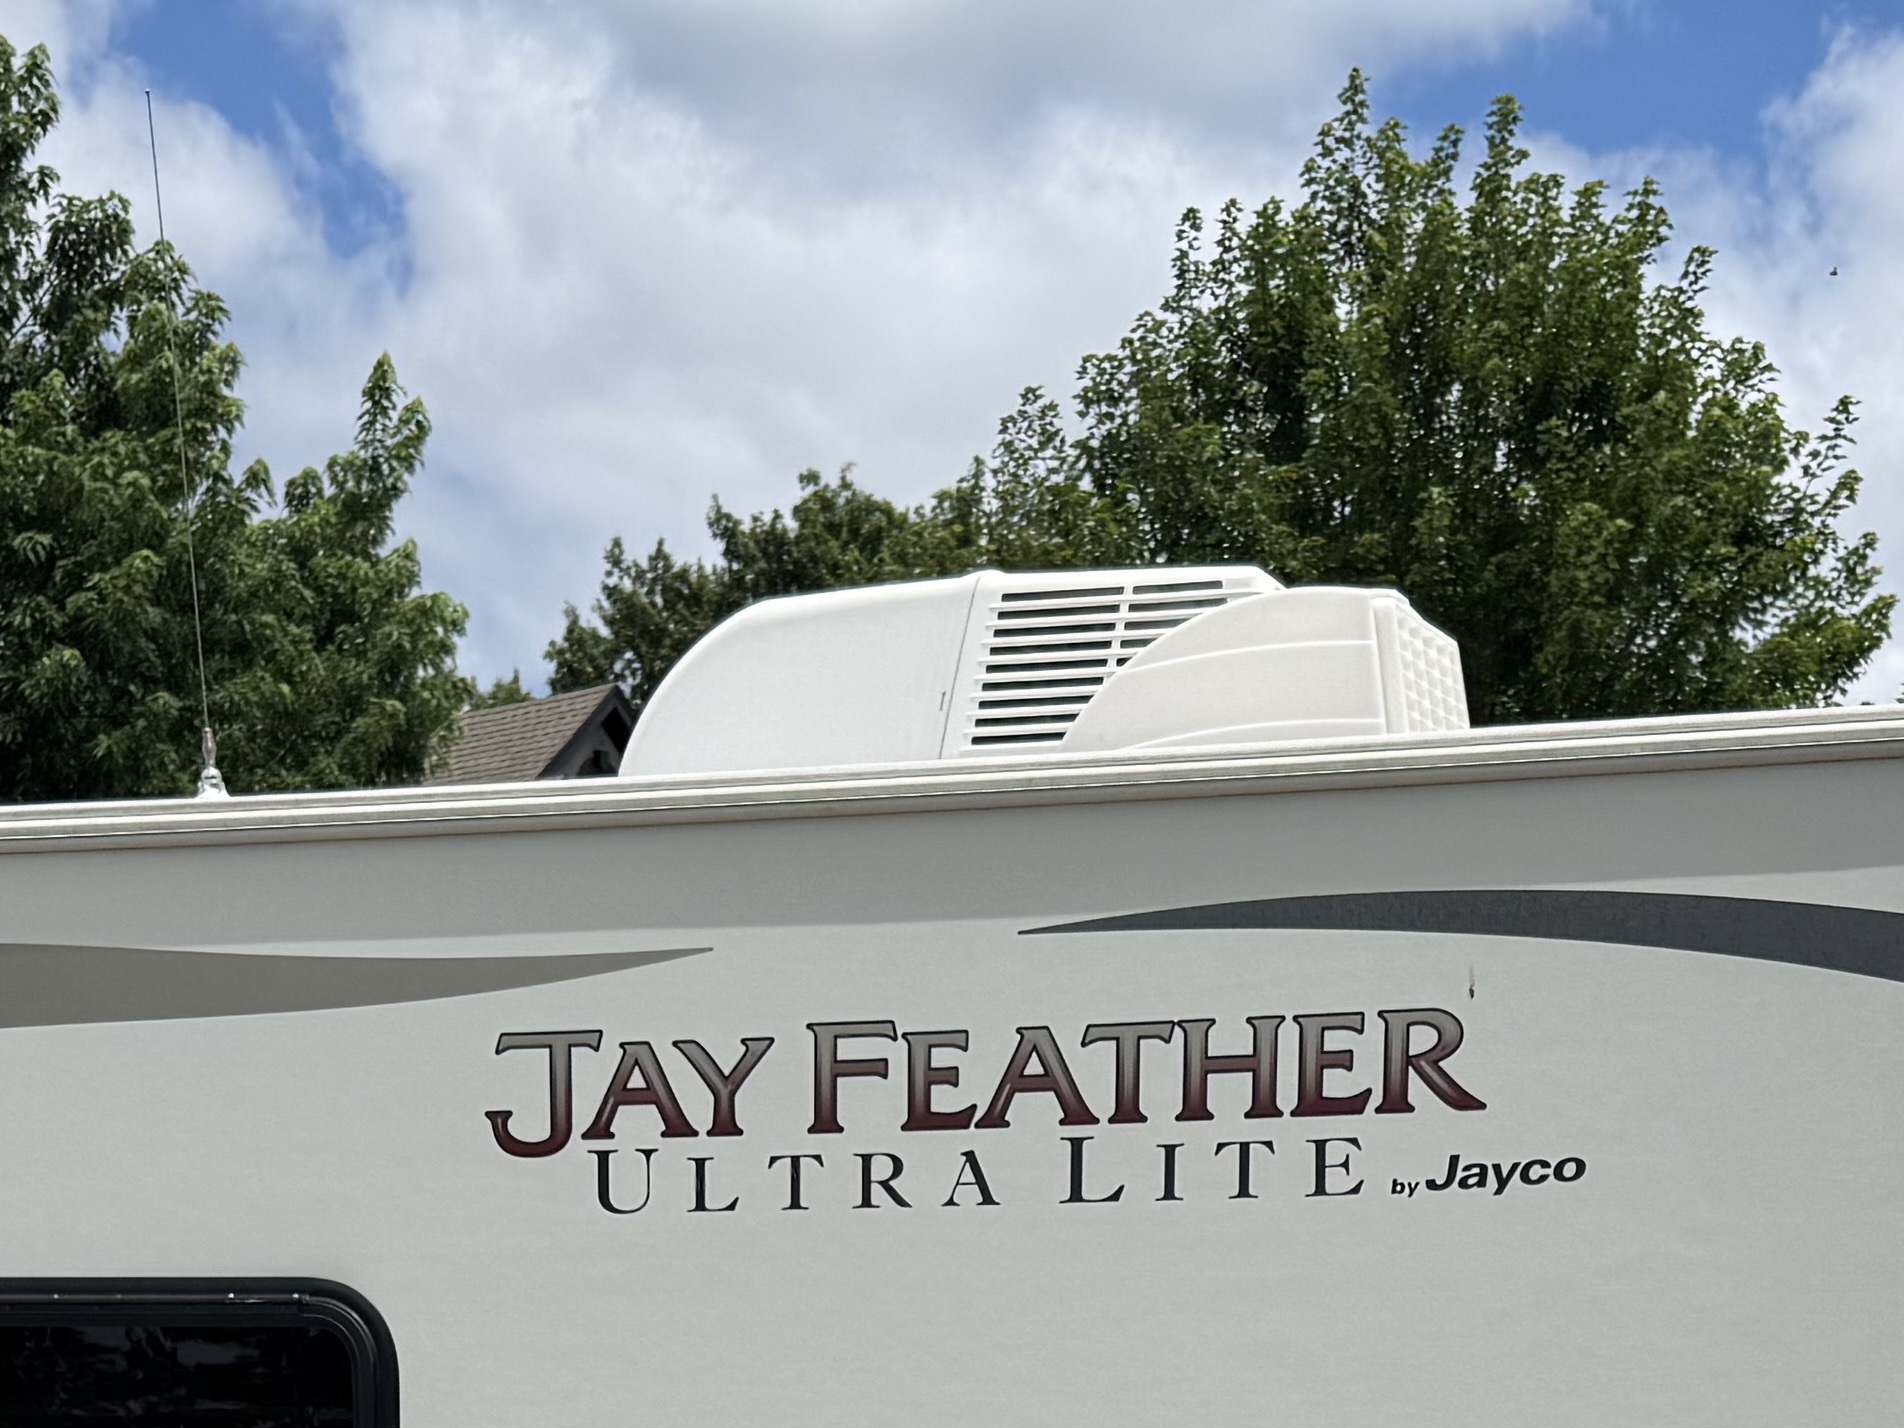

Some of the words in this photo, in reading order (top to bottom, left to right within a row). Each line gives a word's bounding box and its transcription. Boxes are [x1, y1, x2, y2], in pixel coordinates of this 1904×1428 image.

[484, 1029, 776, 1159] JAY
[805, 1007, 1488, 1135] FEATHER
[586, 1148, 1001, 1215] ULTRA
[1058, 1137, 1365, 1204] LITE
[1390, 1178, 1420, 1198] by
[1425, 1153, 1587, 1196] Jayco
